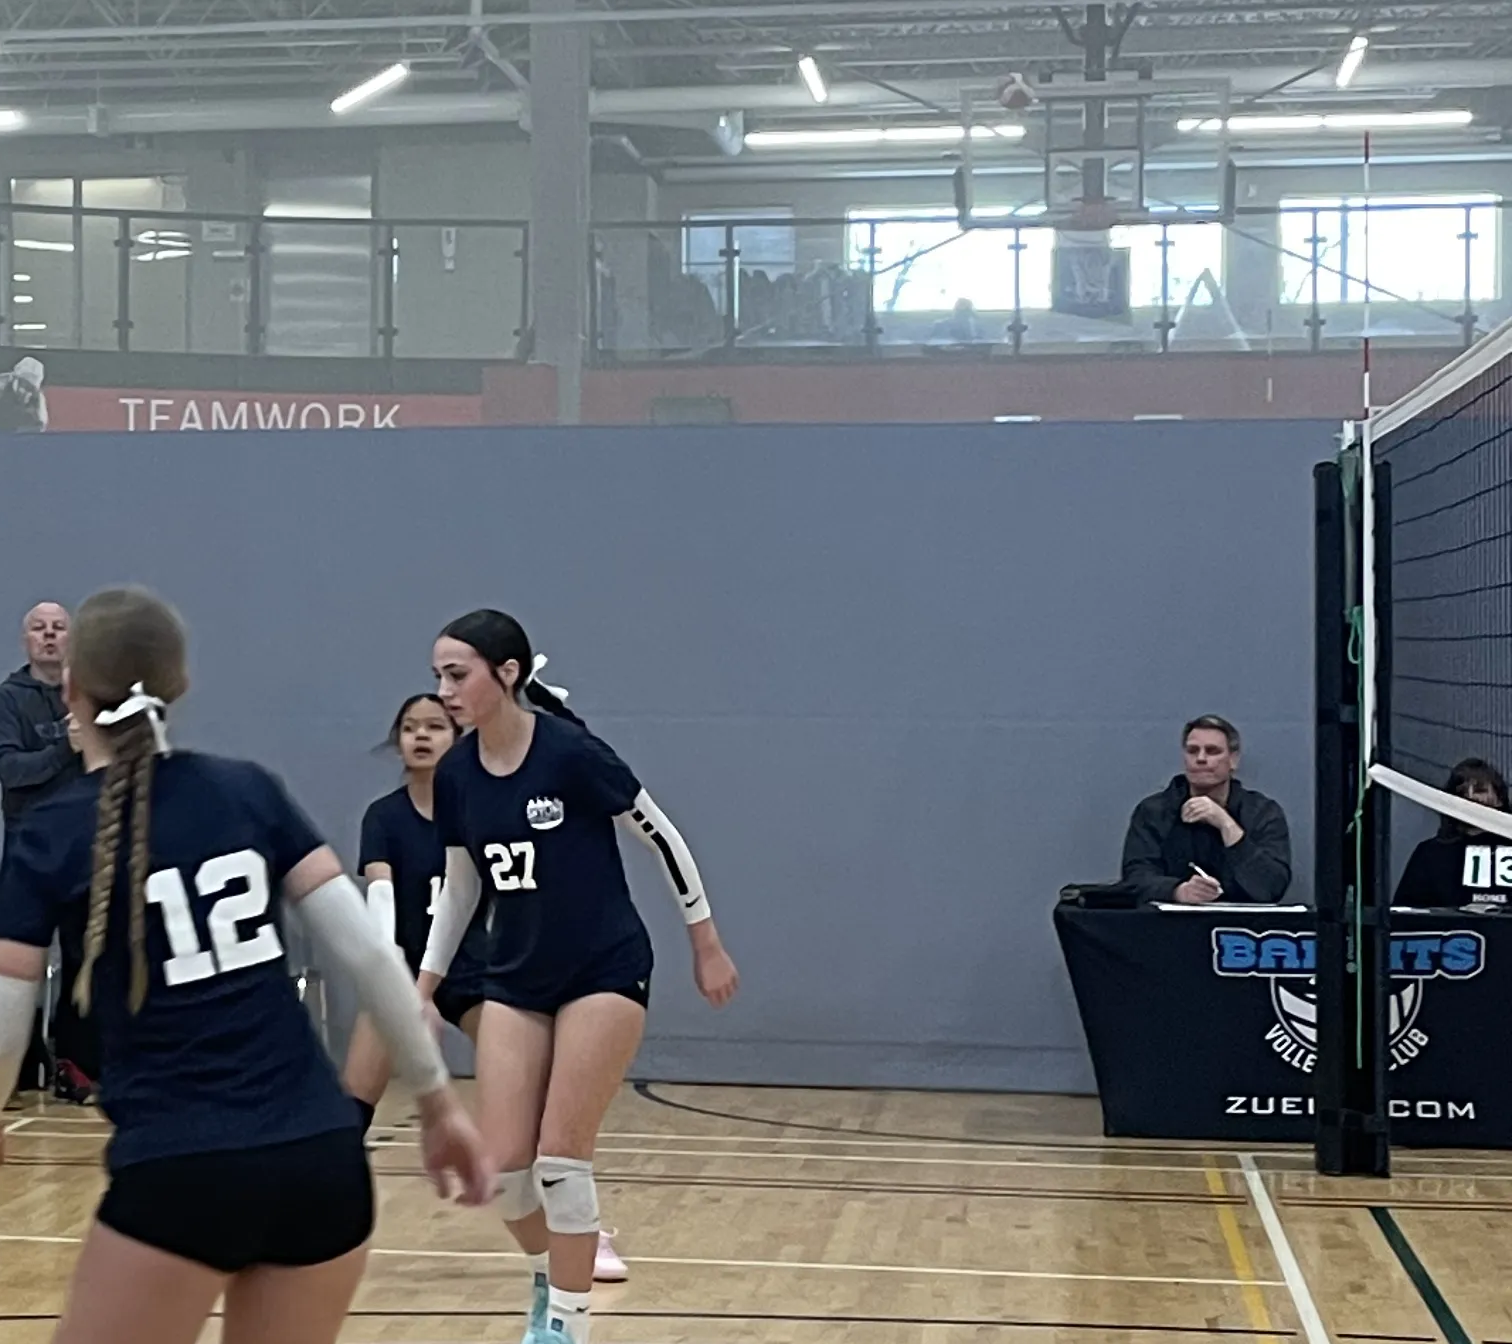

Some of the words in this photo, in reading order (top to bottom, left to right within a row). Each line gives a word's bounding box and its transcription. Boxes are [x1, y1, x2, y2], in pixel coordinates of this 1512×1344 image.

[119, 397, 401, 432] TEAMWORK
[484, 841, 537, 890] 27
[144, 847, 284, 987] 12
